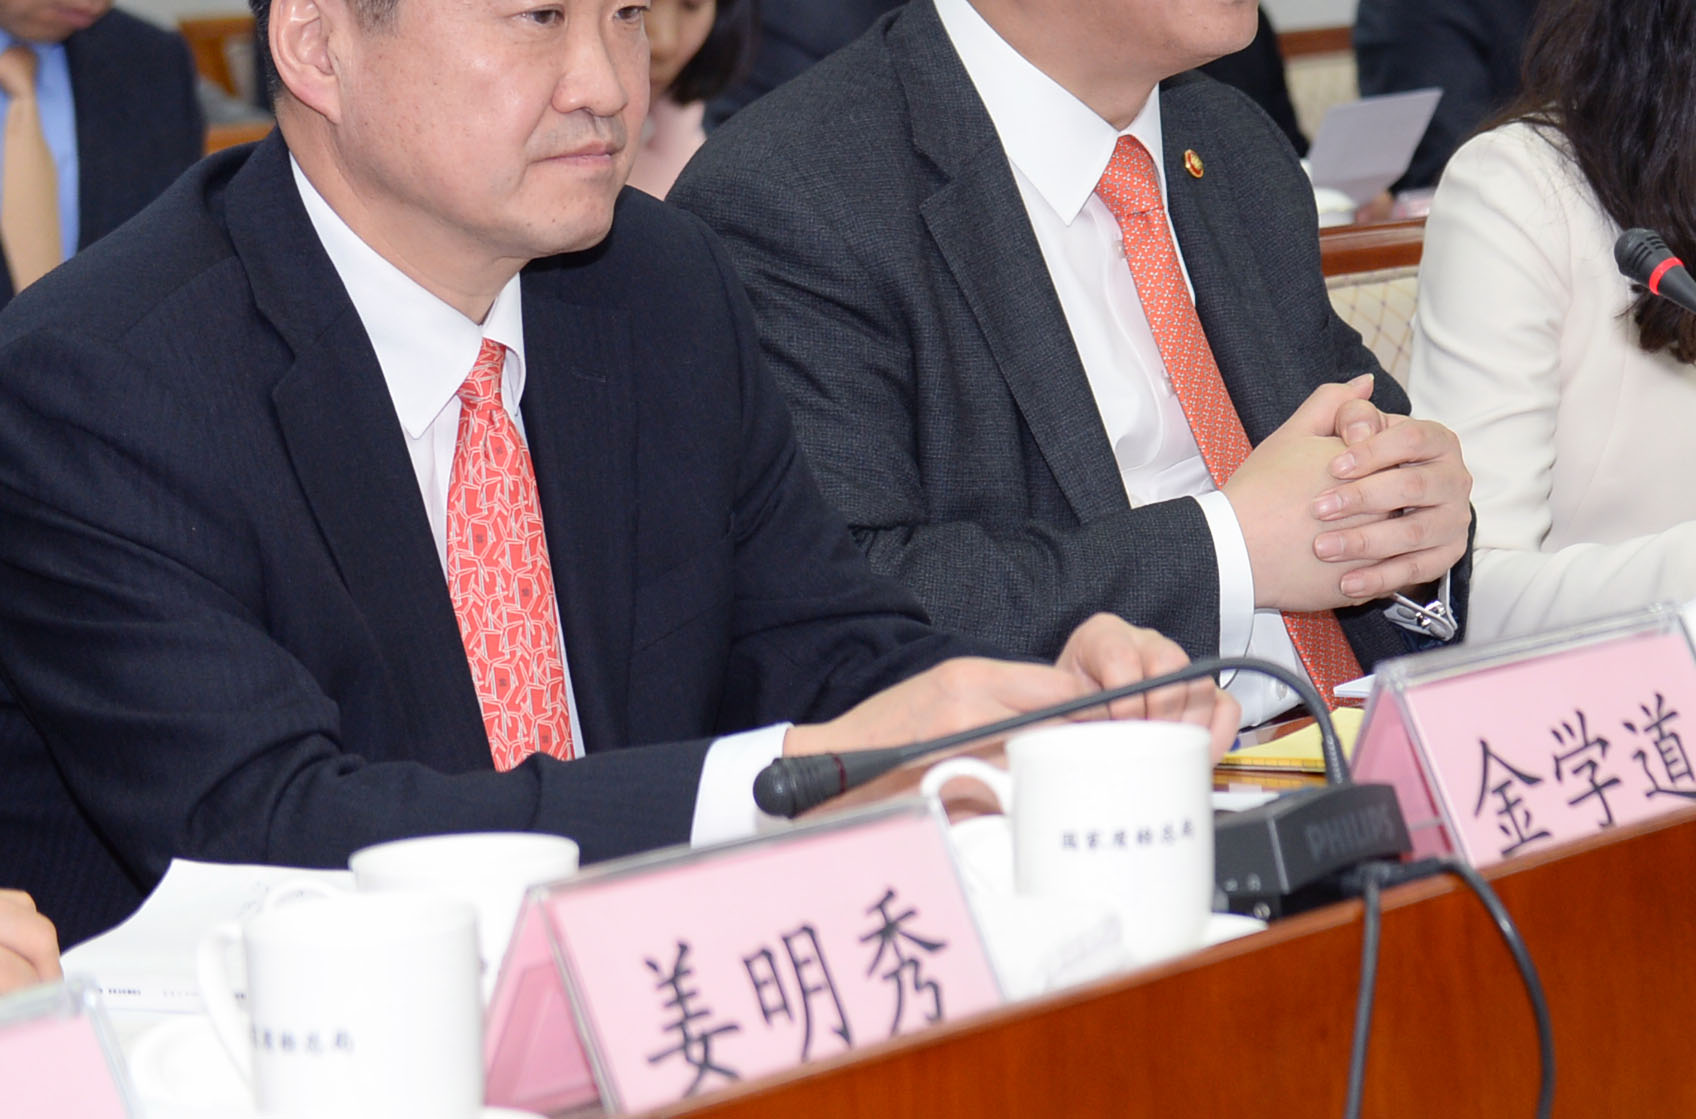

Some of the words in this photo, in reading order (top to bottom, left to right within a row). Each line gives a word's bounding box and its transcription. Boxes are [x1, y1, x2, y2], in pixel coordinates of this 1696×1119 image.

[1304, 802, 1397, 862] PHILIPS
[644, 887, 948, 1099] 姜明秀
